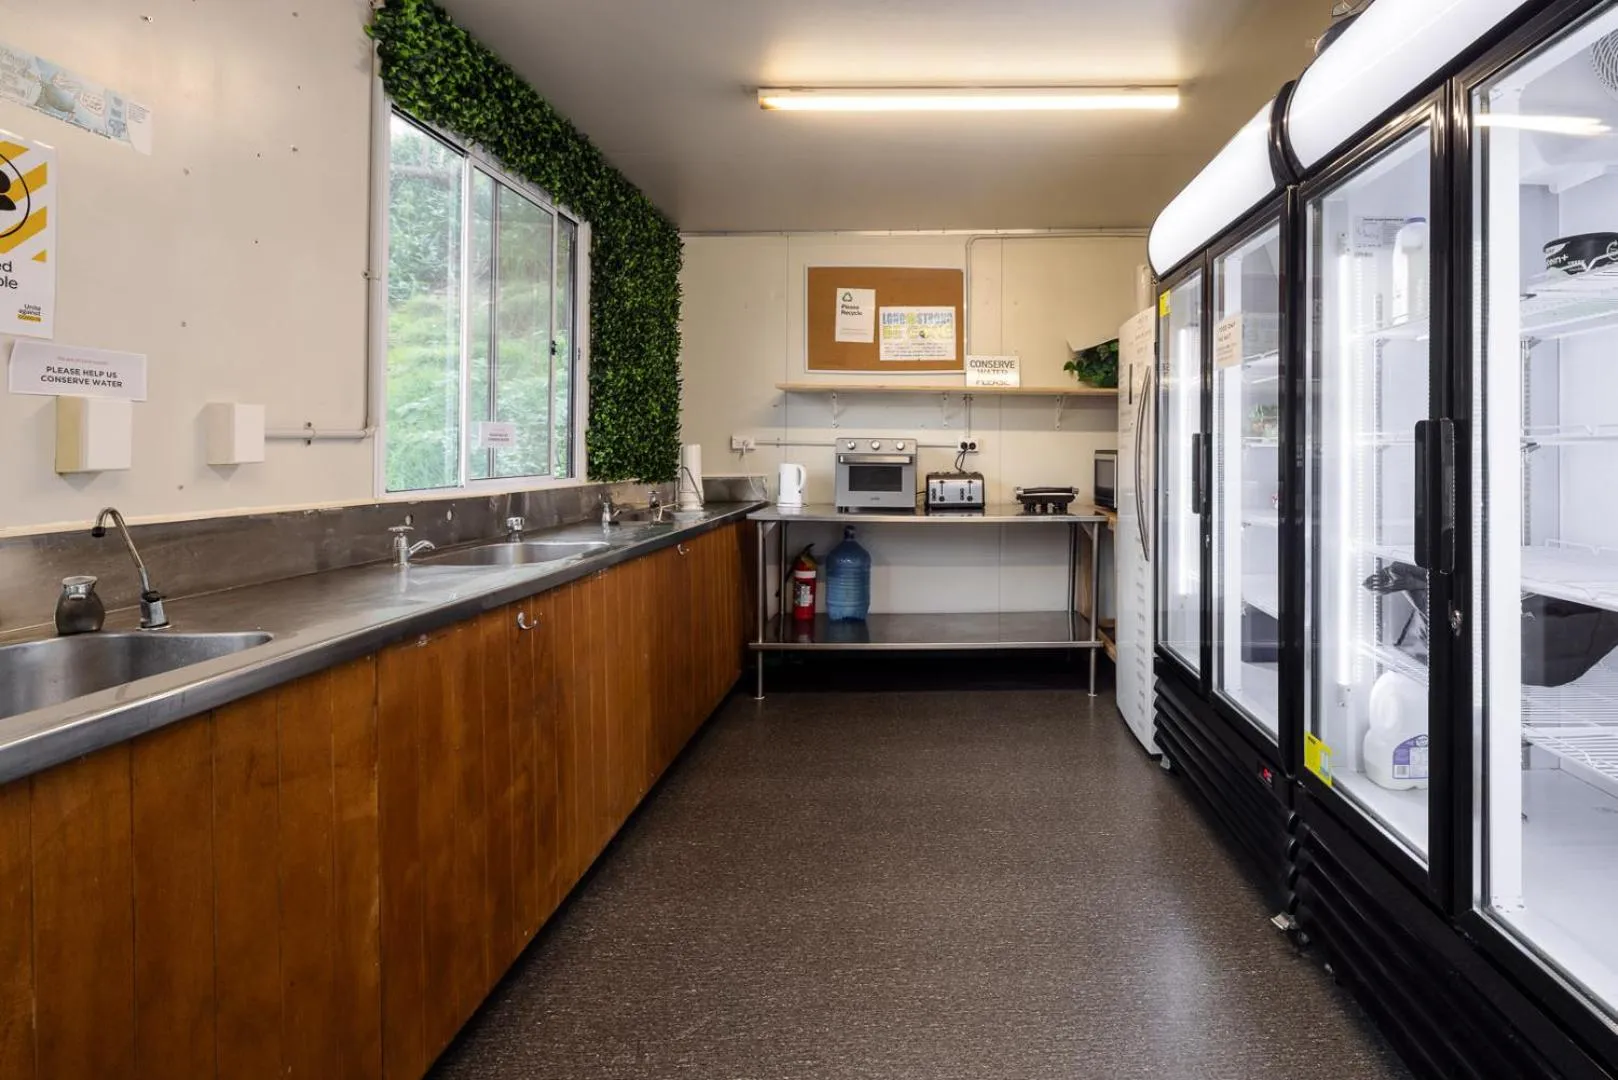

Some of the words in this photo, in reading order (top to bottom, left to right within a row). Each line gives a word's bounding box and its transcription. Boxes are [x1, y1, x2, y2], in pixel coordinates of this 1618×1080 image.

[0, 260, 12, 273] d
[970, 359, 1015, 369] CONSERVE
[46, 365, 81, 376] PLEASE
[82, 369, 105, 378] HELP
[106, 371, 118, 379] US
[40, 375, 91, 385] CONSERVE
[92, 379, 123, 388] WATER
